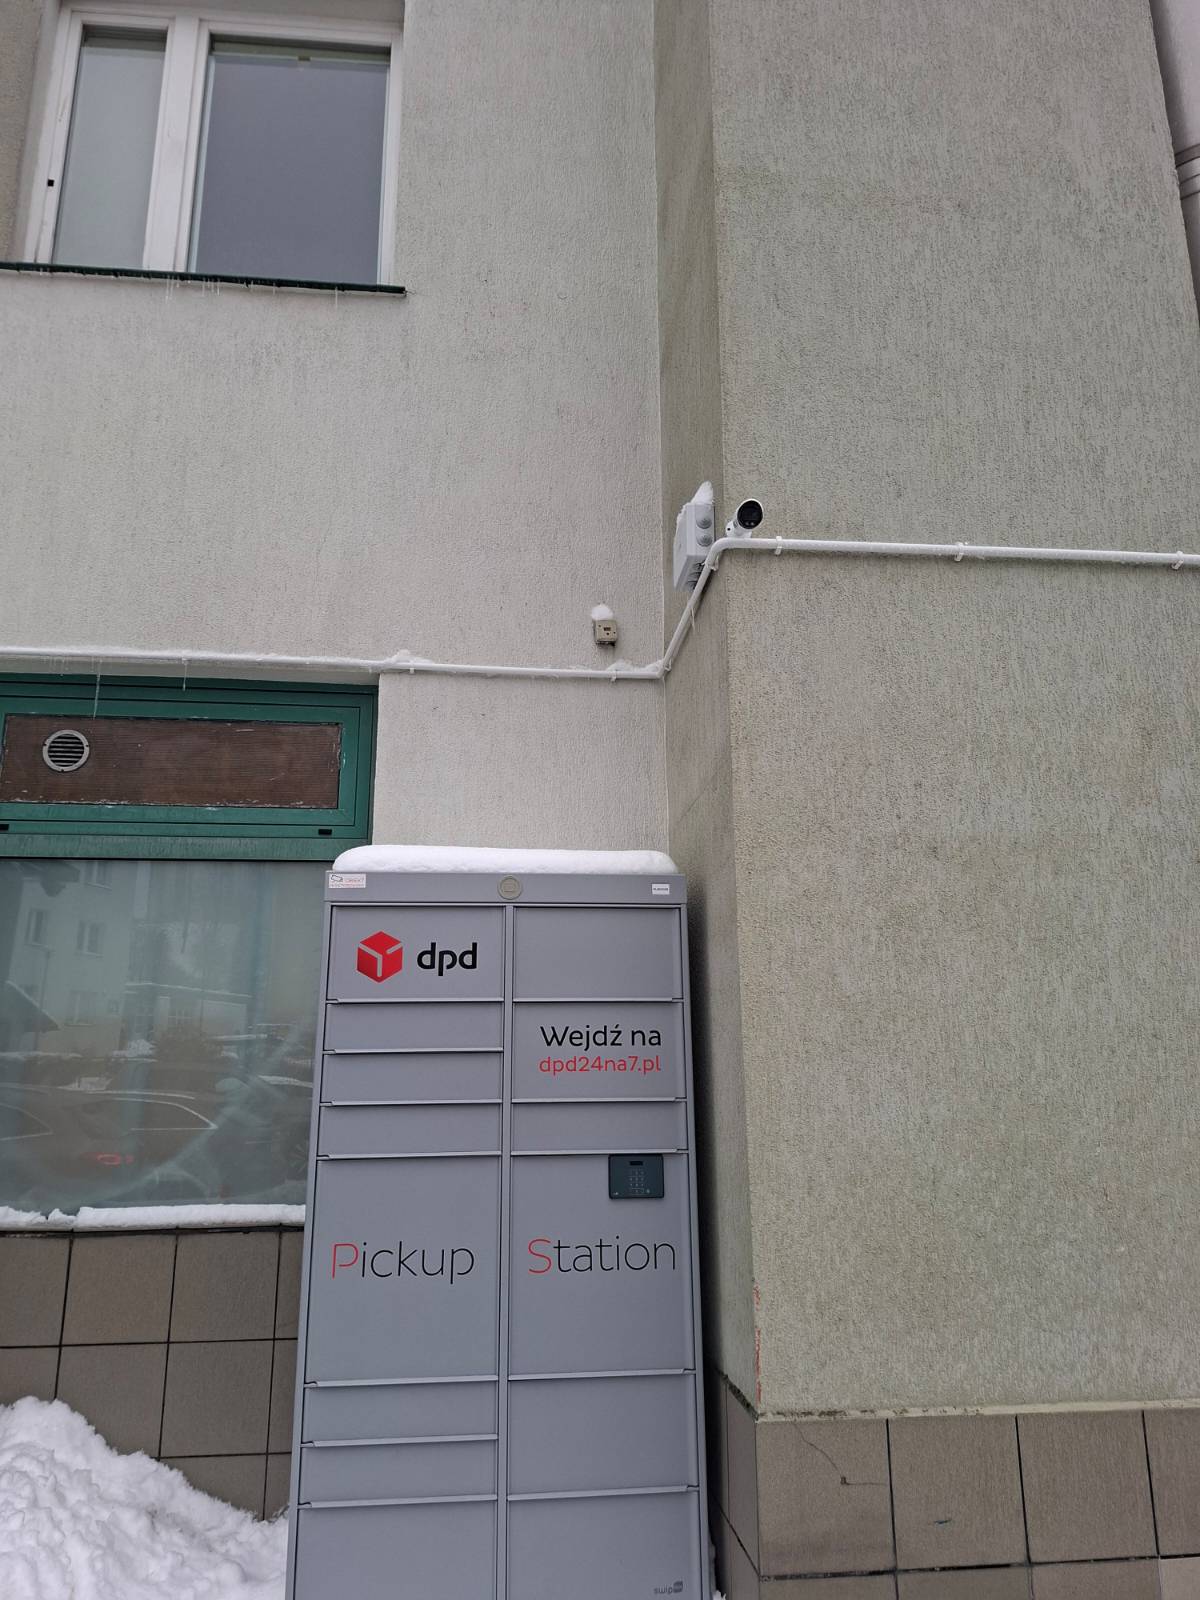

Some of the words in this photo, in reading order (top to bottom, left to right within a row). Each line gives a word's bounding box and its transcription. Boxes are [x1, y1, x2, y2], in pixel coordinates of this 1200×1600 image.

[417, 942, 477, 976] dpd
[540, 1024, 622, 1051] Wejdź
[631, 1029, 662, 1047] na
[539, 1055, 661, 1076] dpd24na7.pl
[332, 1241, 475, 1284] Pickup
[528, 1236, 676, 1274] Station
